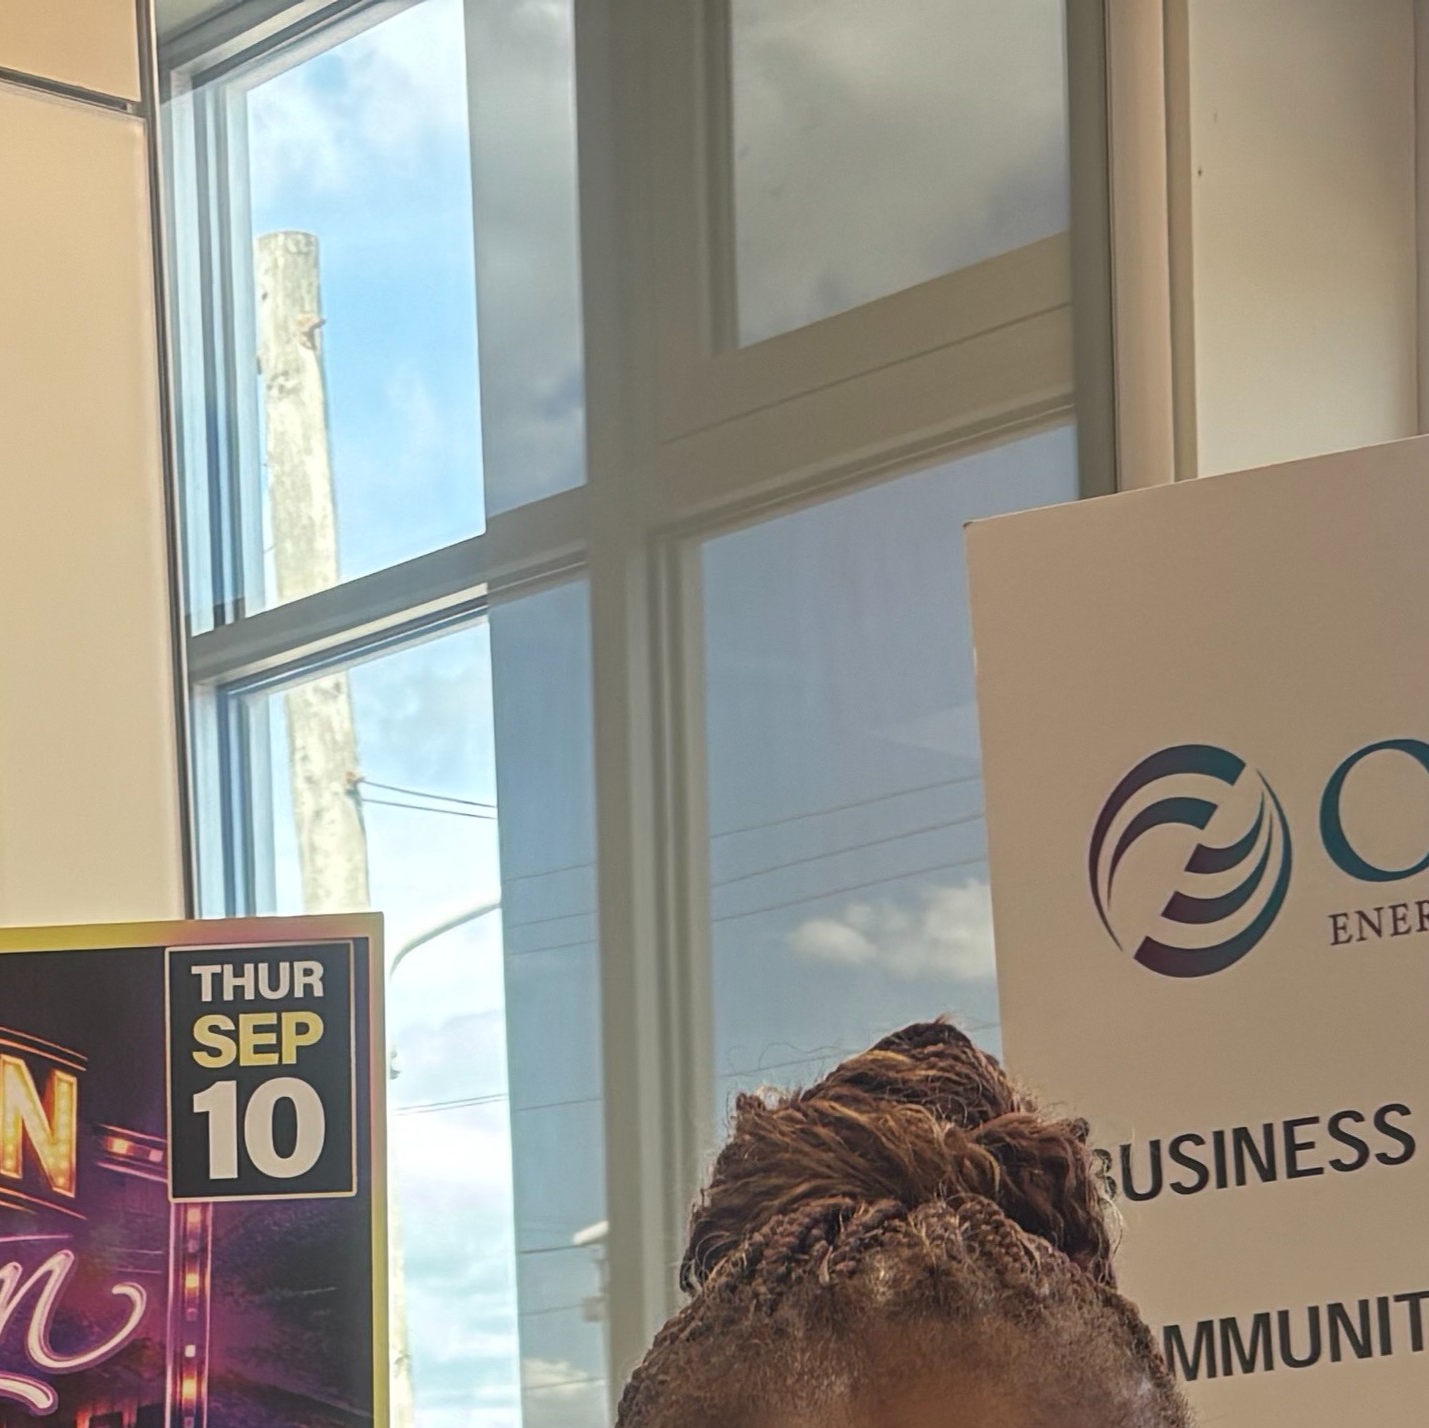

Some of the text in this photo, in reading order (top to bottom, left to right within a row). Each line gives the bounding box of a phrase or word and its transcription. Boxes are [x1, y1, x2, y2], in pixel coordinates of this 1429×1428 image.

[190, 961, 324, 1001] THUR
[190, 1012, 324, 1068] SEP
[191, 1078, 325, 1180] 10
